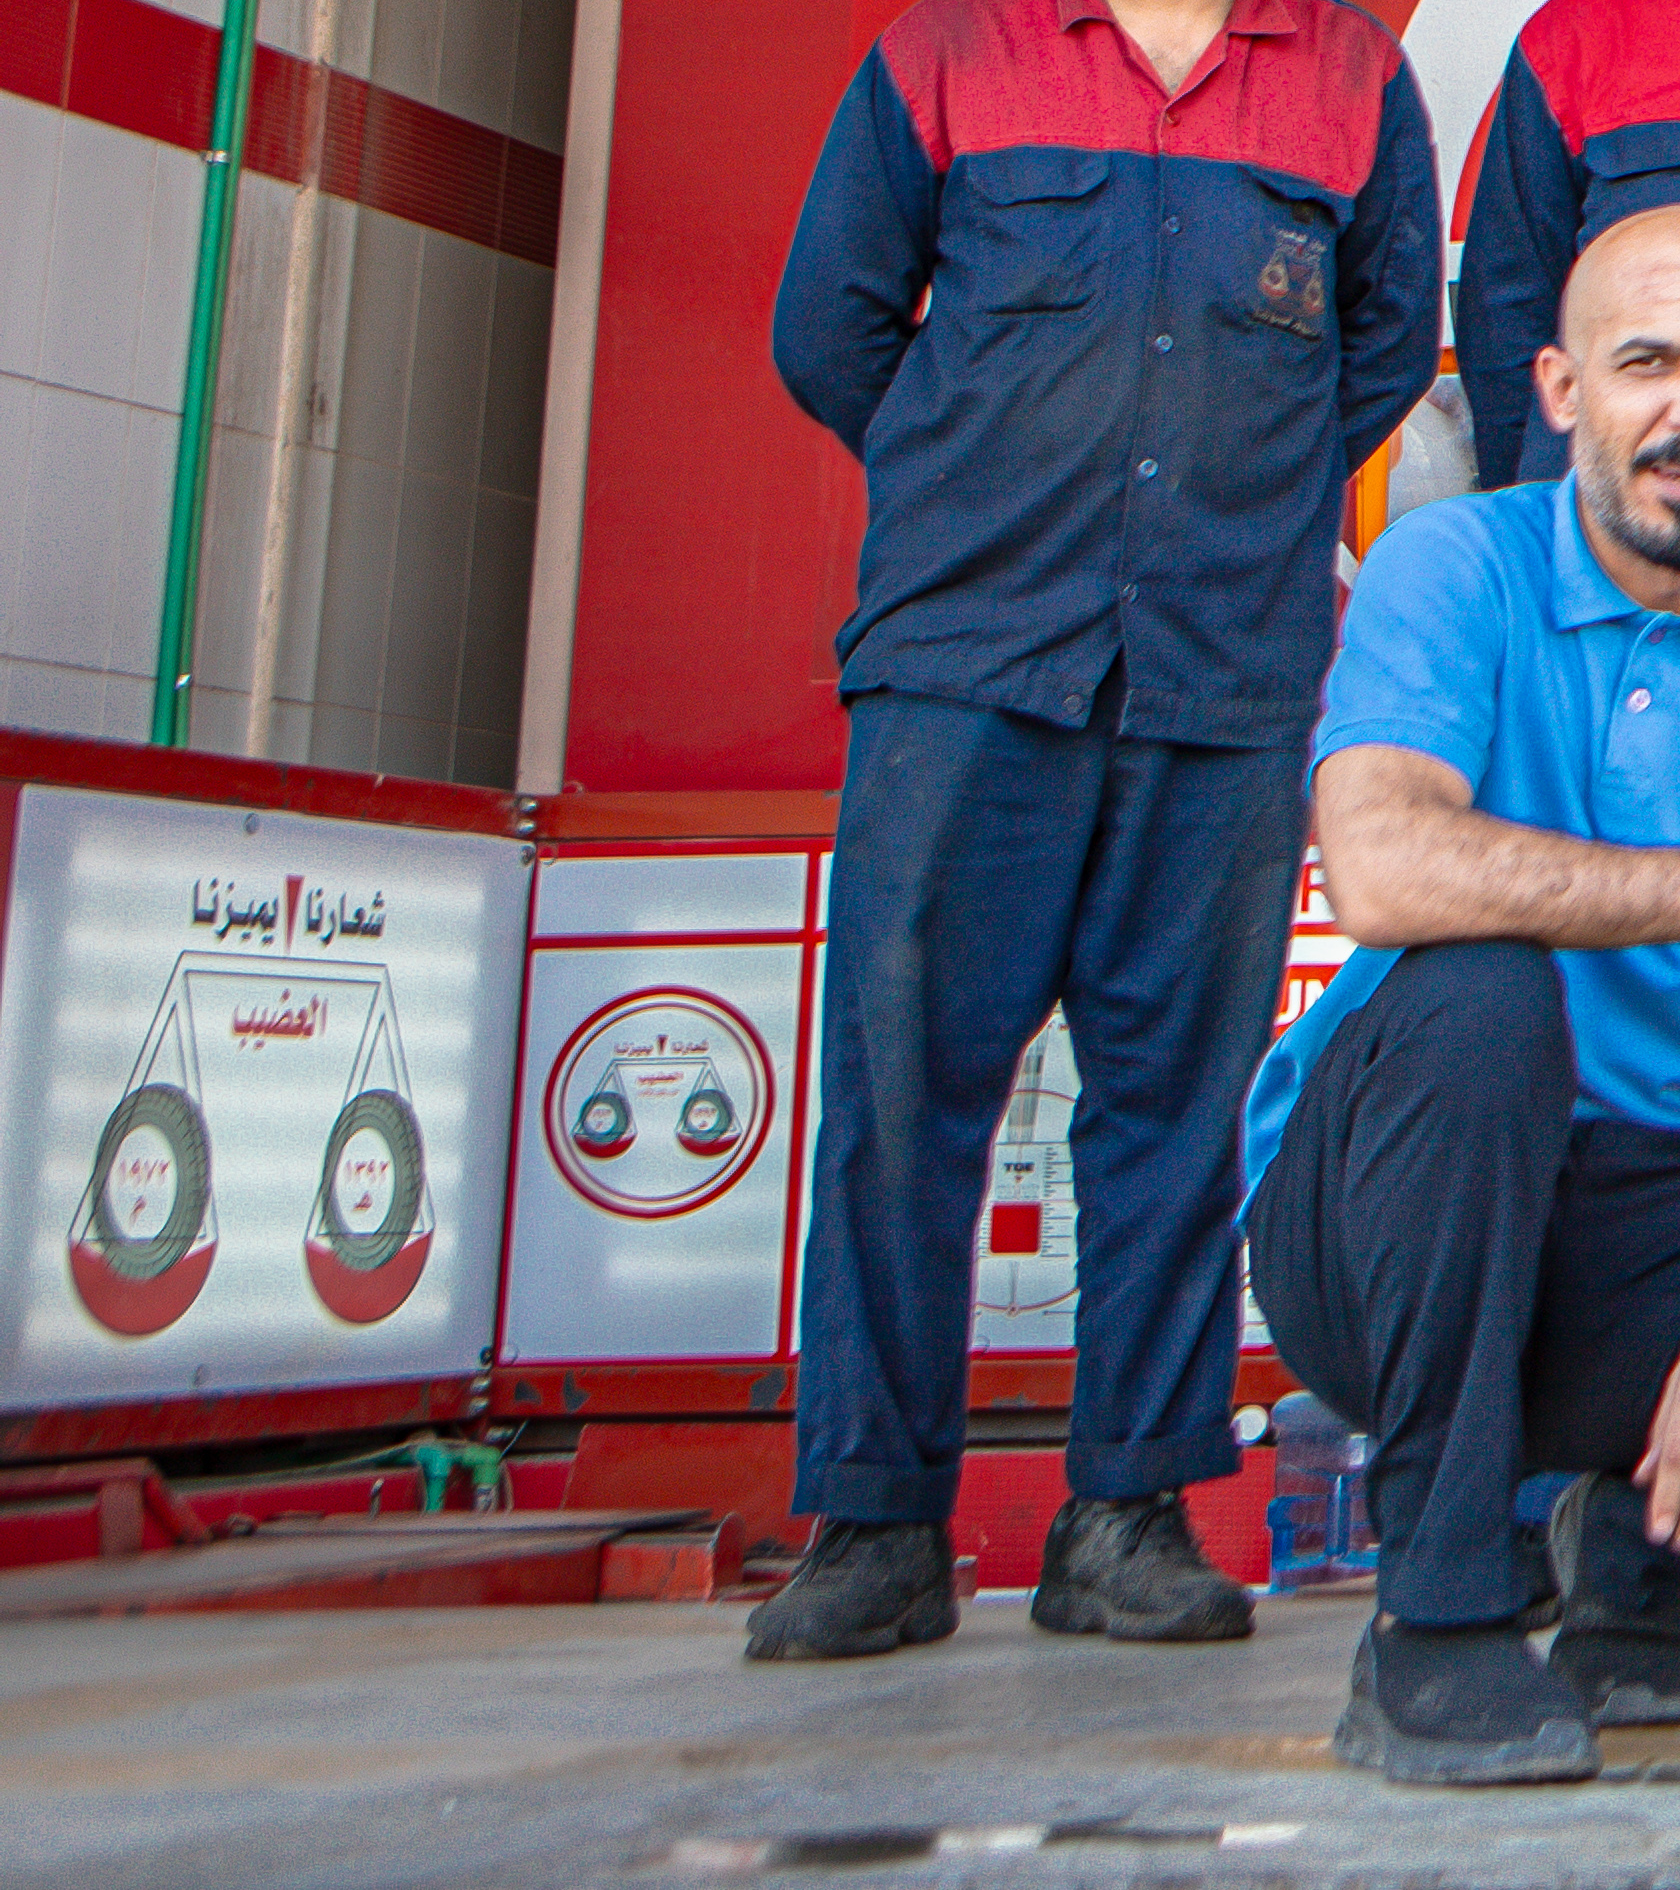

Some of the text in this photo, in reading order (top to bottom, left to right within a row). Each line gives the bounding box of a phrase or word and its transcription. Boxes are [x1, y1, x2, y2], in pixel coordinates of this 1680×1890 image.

[192, 877, 387, 948] شعارنا يميزنا
[231, 988, 329, 1050] العضيب
